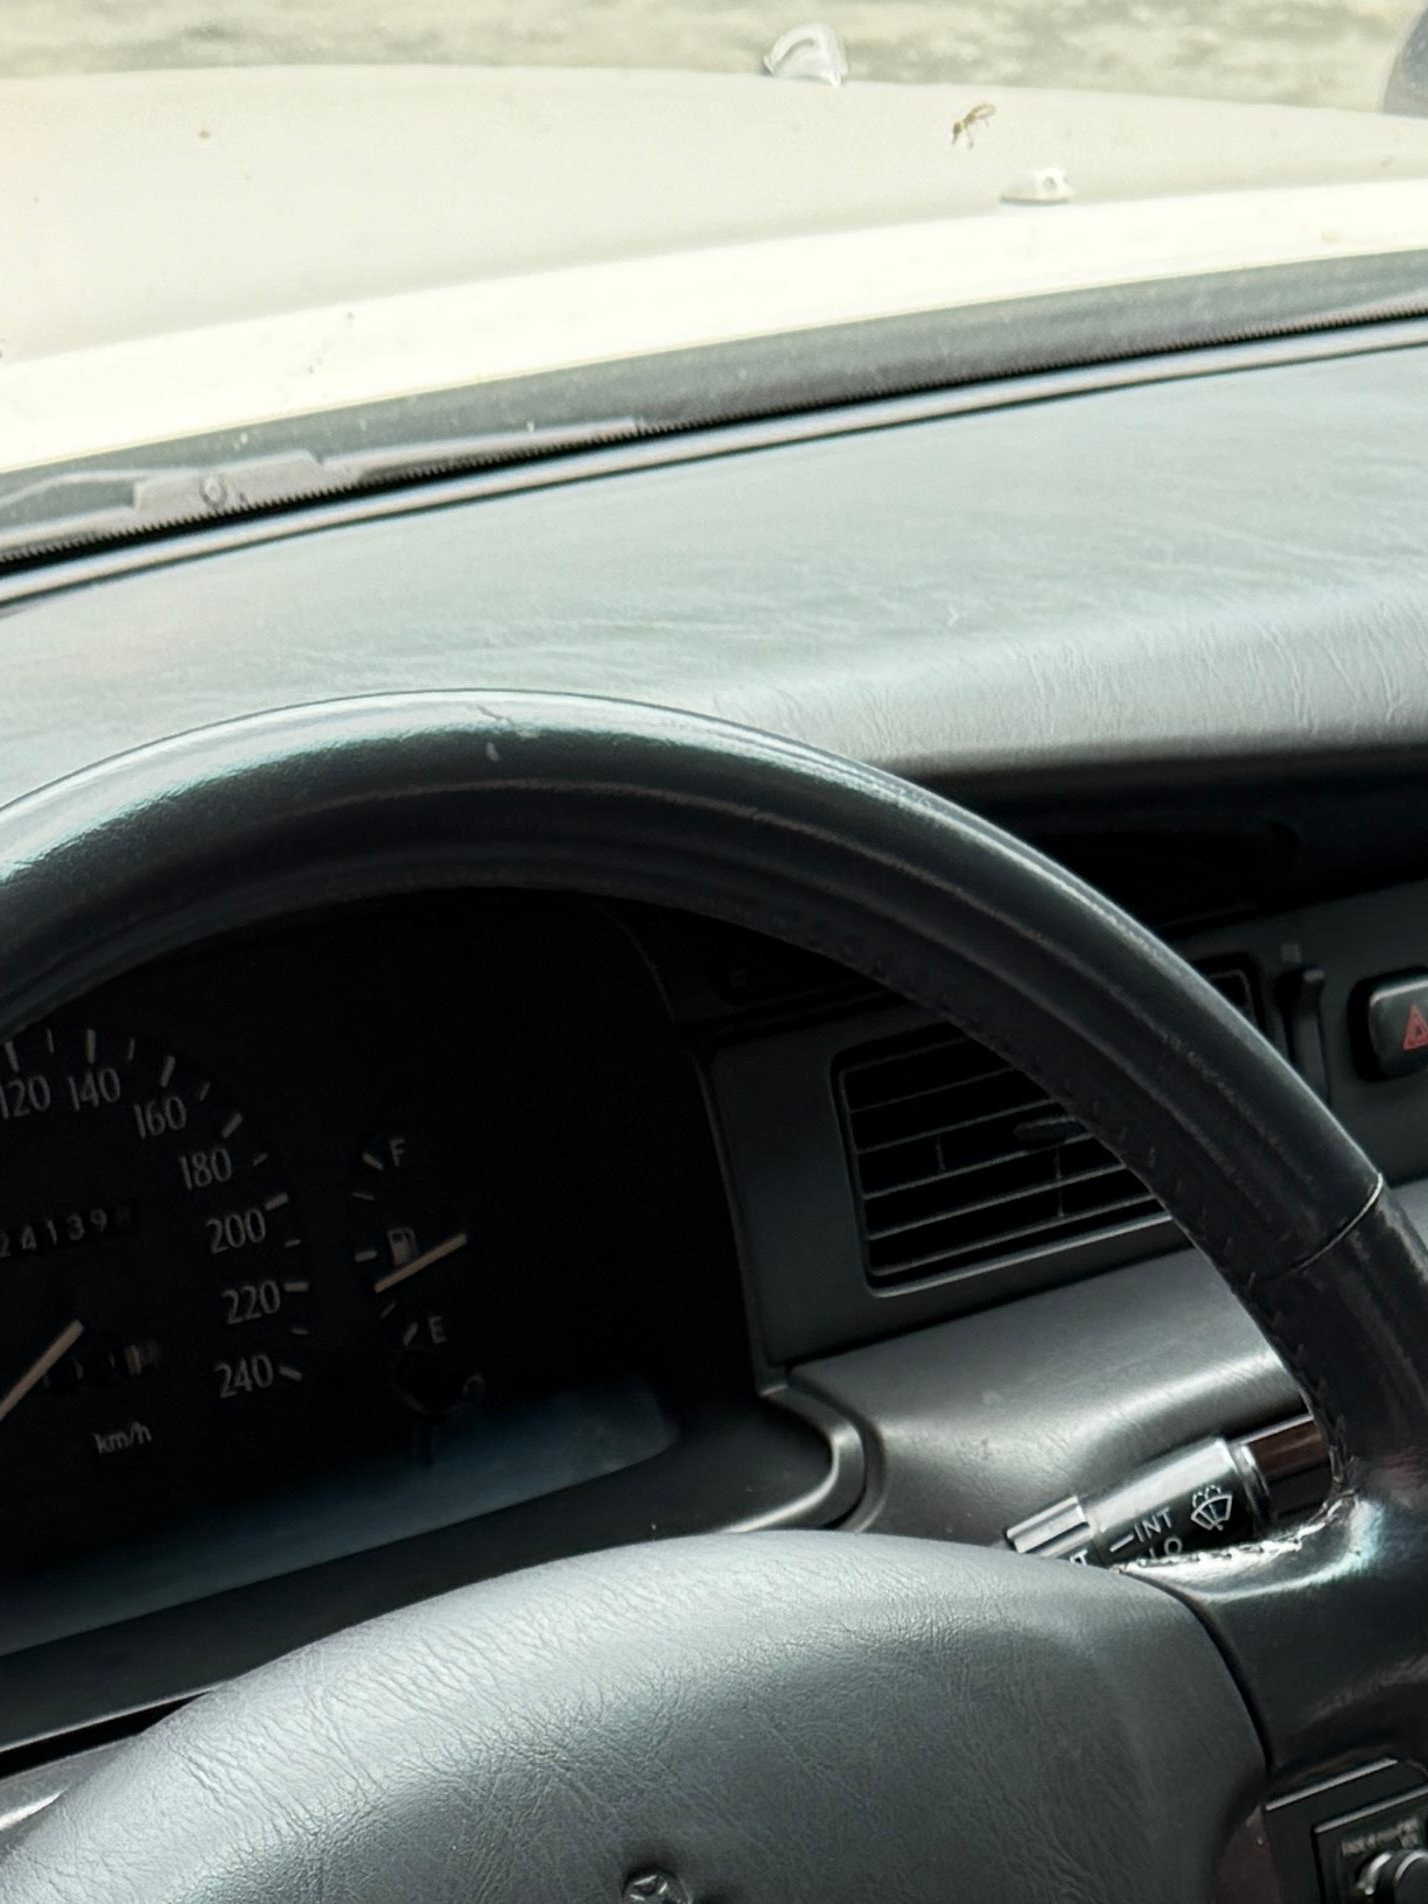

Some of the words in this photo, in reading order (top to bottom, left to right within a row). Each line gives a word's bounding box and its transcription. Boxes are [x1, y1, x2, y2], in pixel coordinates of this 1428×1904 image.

[67, 1067, 122, 1112] 140
[133, 1095, 188, 1139] 160
[178, 1147, 233, 1191] 180
[389, 1136, 407, 1167] F
[205, 1208, 267, 1255] 200
[220, 1279, 281, 1326] 220
[213, 1352, 272, 1400] 240
[91, 1419, 153, 1457] km/h
[1133, 1506, 1172, 1543] INT
